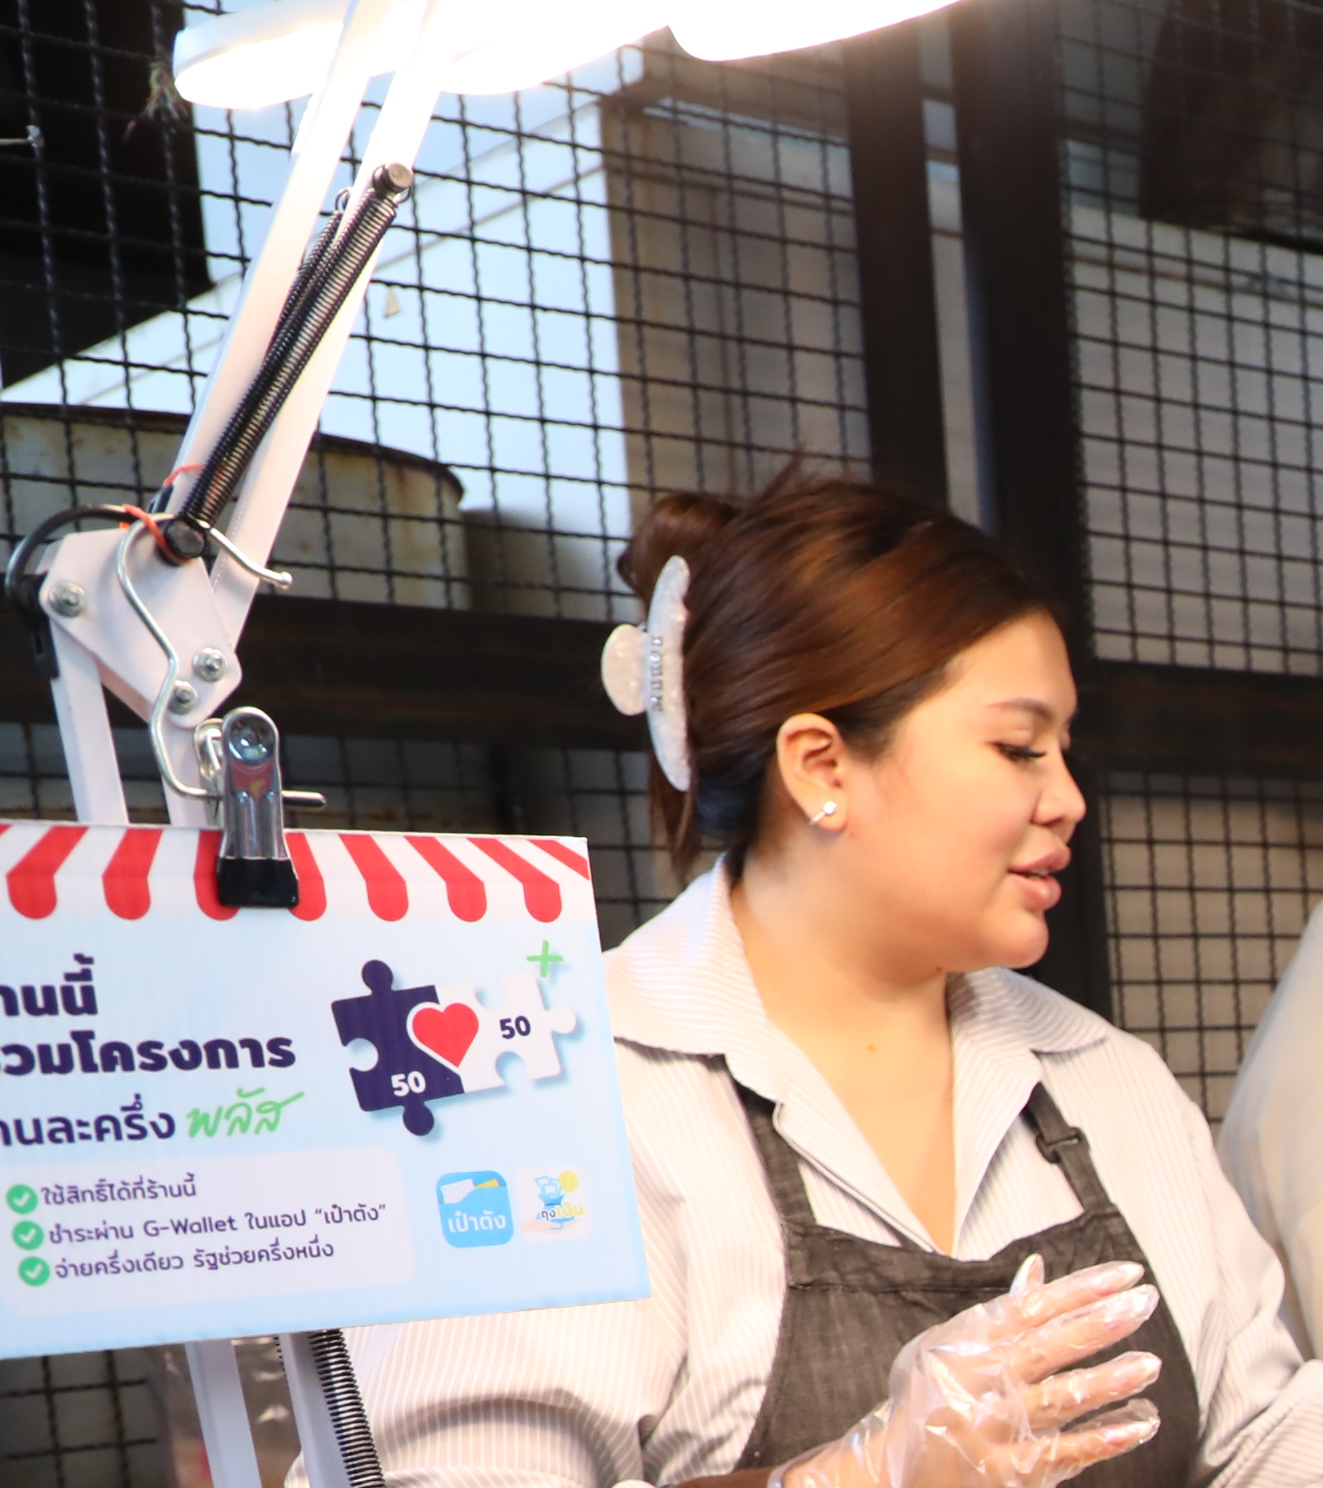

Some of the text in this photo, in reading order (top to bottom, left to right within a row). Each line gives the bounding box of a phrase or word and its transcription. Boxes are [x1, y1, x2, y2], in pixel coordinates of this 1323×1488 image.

[499, 1015, 532, 1040] 50
[0, 1029, 297, 1075] วมโครงการ
[390, 1070, 427, 1097] 50
[186, 1086, 305, 1139] พลัส
[40, 1172, 198, 1207] ใช้สิทธิ์ได้ที่ร้านนี้
[49, 1220, 135, 1245] ชำระผ่าน
[143, 1215, 238, 1238] G-Wallet
[244, 1208, 307, 1230] ในแอป
[447, 1209, 507, 1234] เป๋าตัง
[54, 1235, 335, 1279] จ่ายครึ่งเดียว รัฐช่วยครึ่งหนึ่ง
